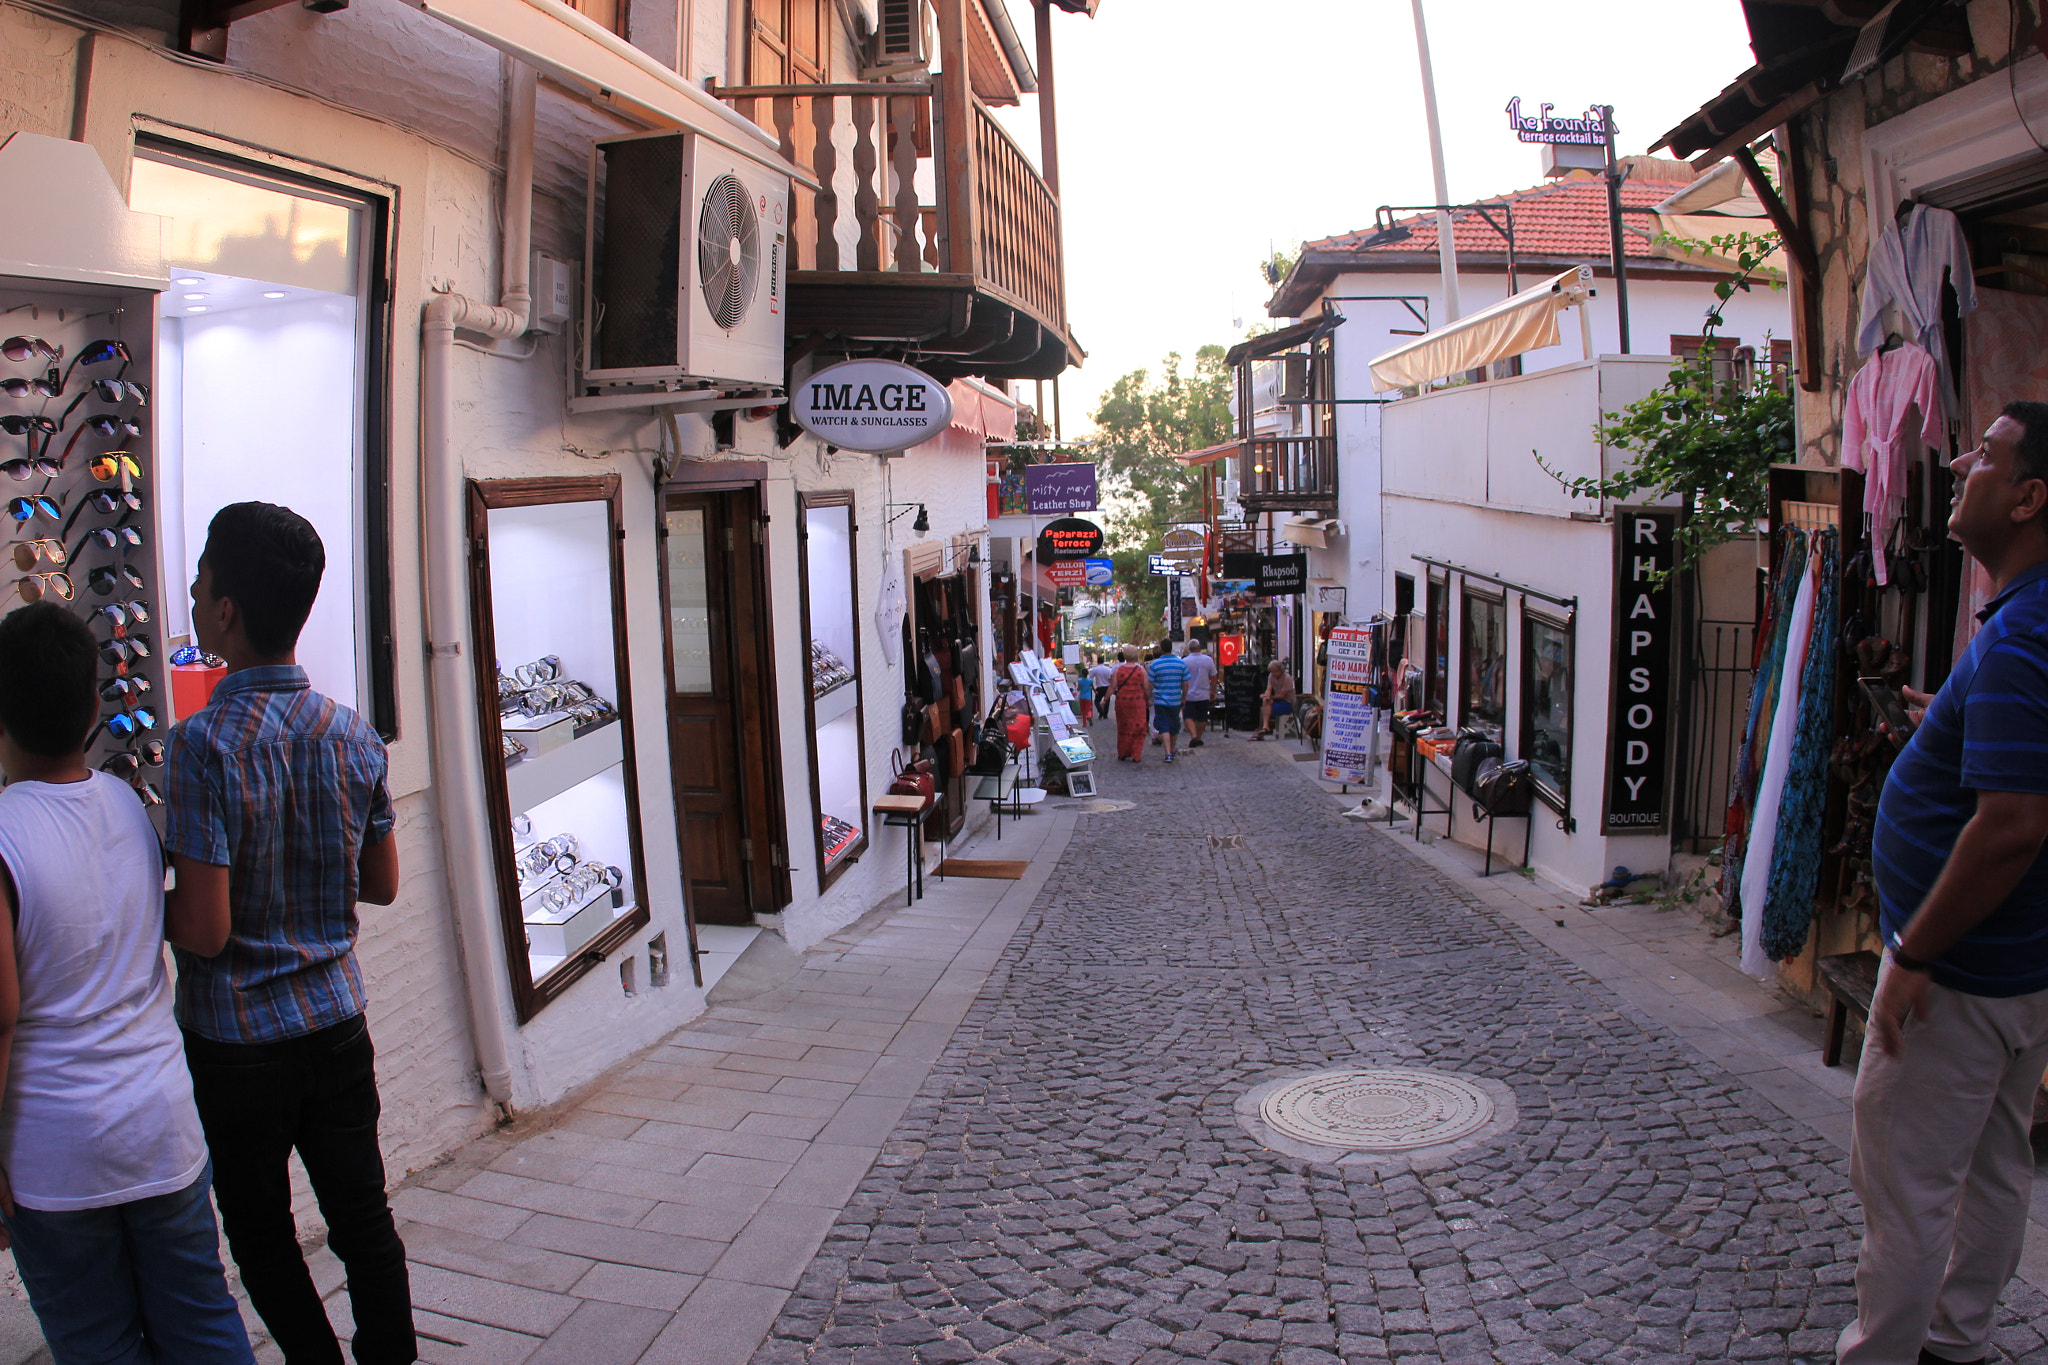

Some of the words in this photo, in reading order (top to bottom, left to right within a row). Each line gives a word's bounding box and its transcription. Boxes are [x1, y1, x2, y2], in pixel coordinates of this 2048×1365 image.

[1505, 95, 1537, 130] The
[1540, 103, 1619, 133] Fountai
[1520, 131, 1555, 142] terrace
[1555, 131, 1591, 144] cocktail
[810, 383, 926, 411] IMAGE
[811, 416, 848, 426] WATCH
[850, 416, 859, 426] &
[861, 417, 928, 427] SUNGLASSES
[1032, 483, 1061, 497] misty
[1032, 500, 1068, 510] Leather
[1069, 499, 1091, 510] Shop
[1045, 529, 1098, 539] Paparazzi
[1052, 539, 1091, 548] Terrace
[1332, 632, 1348, 640] BUY
[1623, 517, 1659, 801] RHAPSODY
[1334, 683, 1364, 693] TEKE
[1609, 812, 1660, 824] BOUTIQUE
